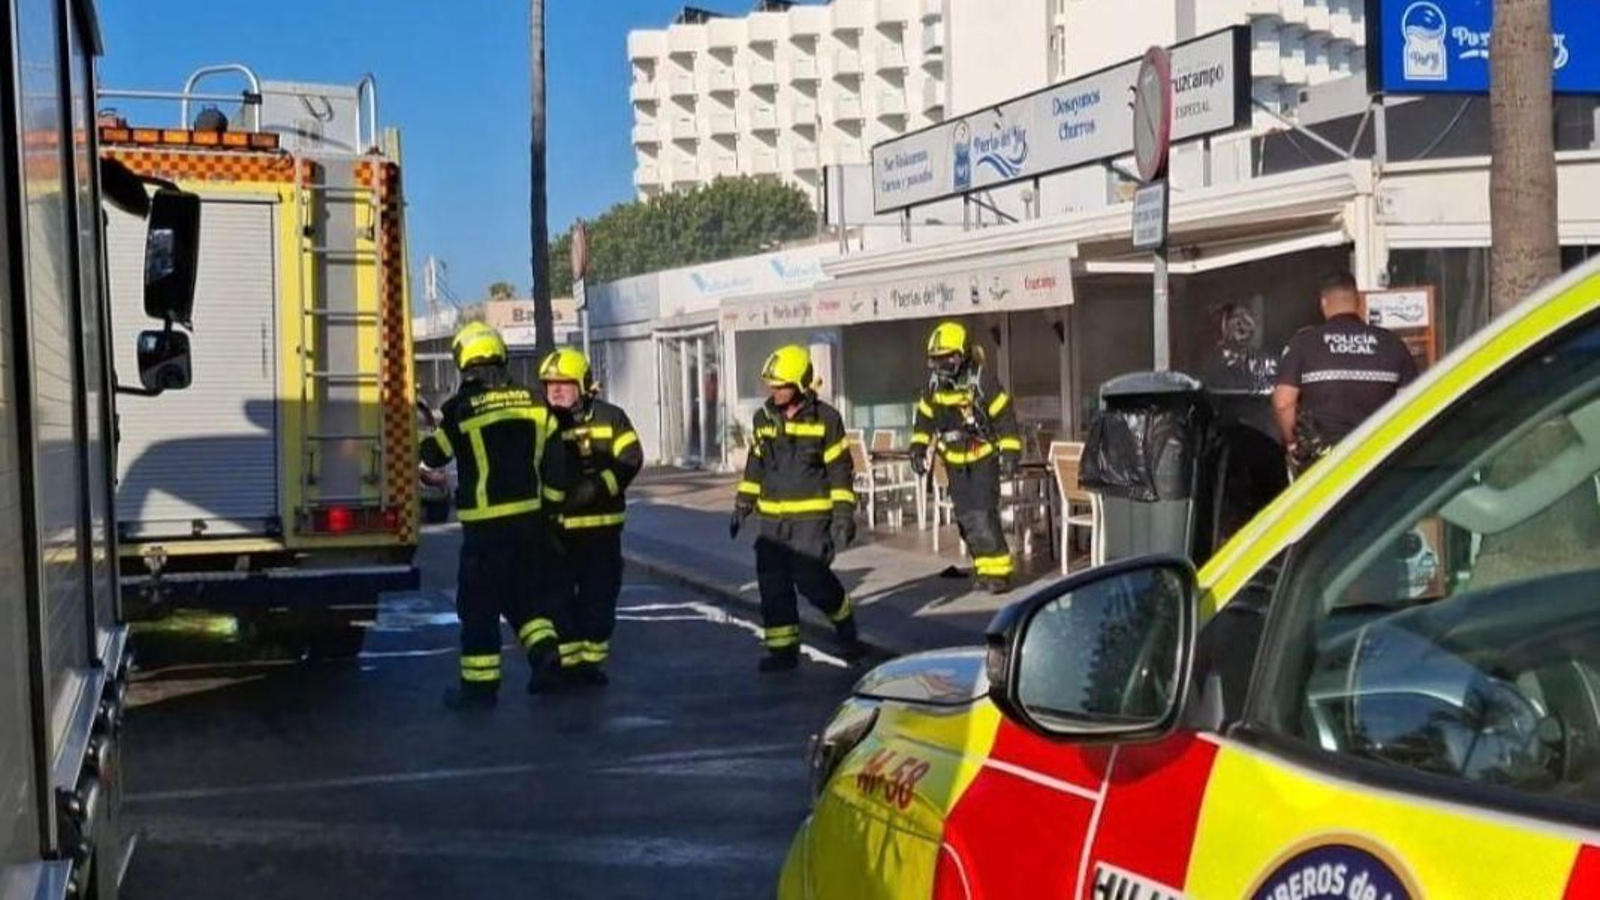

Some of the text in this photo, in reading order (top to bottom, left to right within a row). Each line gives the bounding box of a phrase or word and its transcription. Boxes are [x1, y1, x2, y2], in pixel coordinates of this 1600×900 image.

[1052, 89, 1101, 116] Desayunos
[1175, 101, 1210, 119] ESPECIAL
[1058, 118, 1096, 141] Churros
[1330, 343, 1377, 355] LOCAL
[1347, 870, 1378, 900] de
